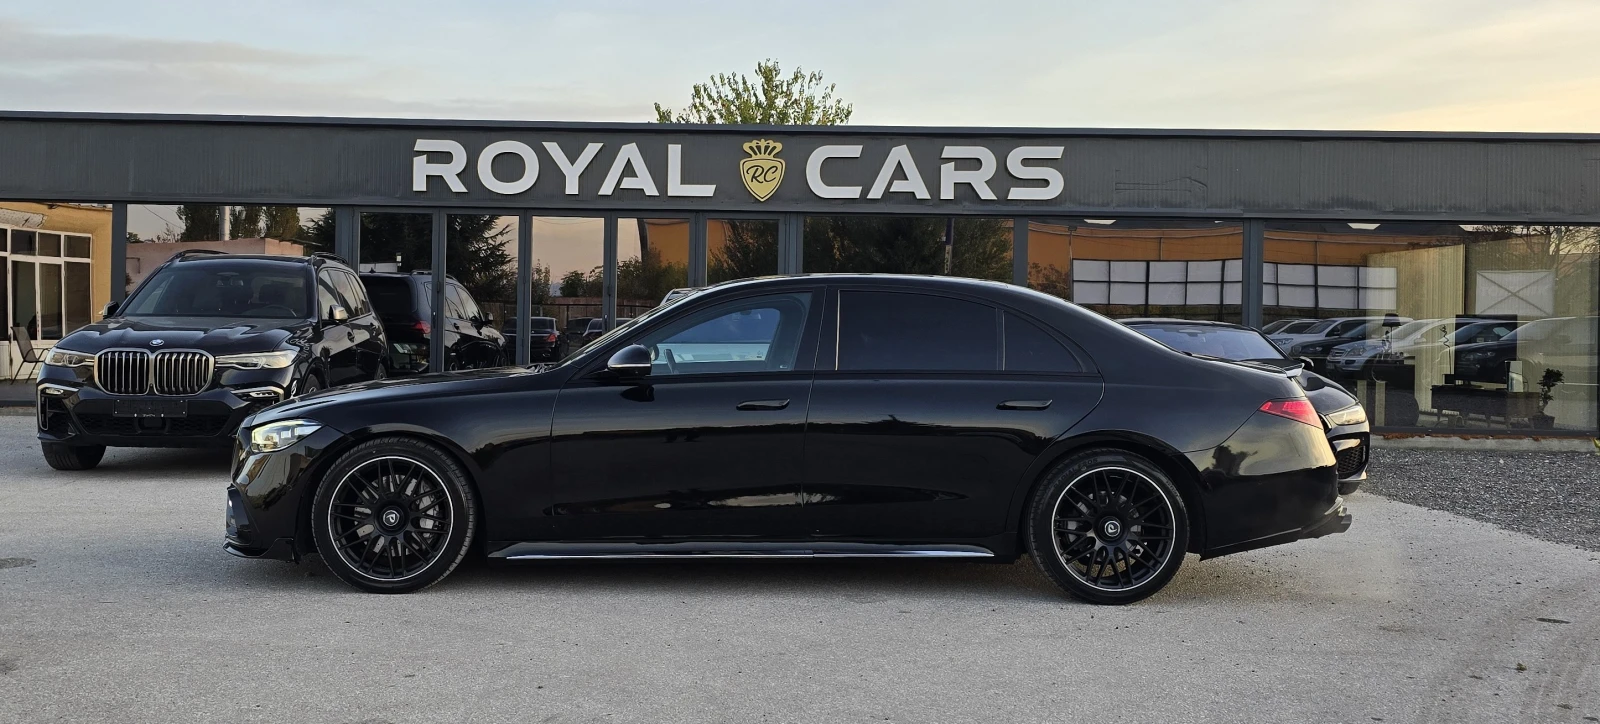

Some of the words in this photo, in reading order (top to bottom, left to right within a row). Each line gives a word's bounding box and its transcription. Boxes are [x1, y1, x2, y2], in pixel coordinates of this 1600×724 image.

[412, 138, 717, 197] ROYAL
[805, 143, 1065, 201] CARS
[746, 164, 778, 184] RC
